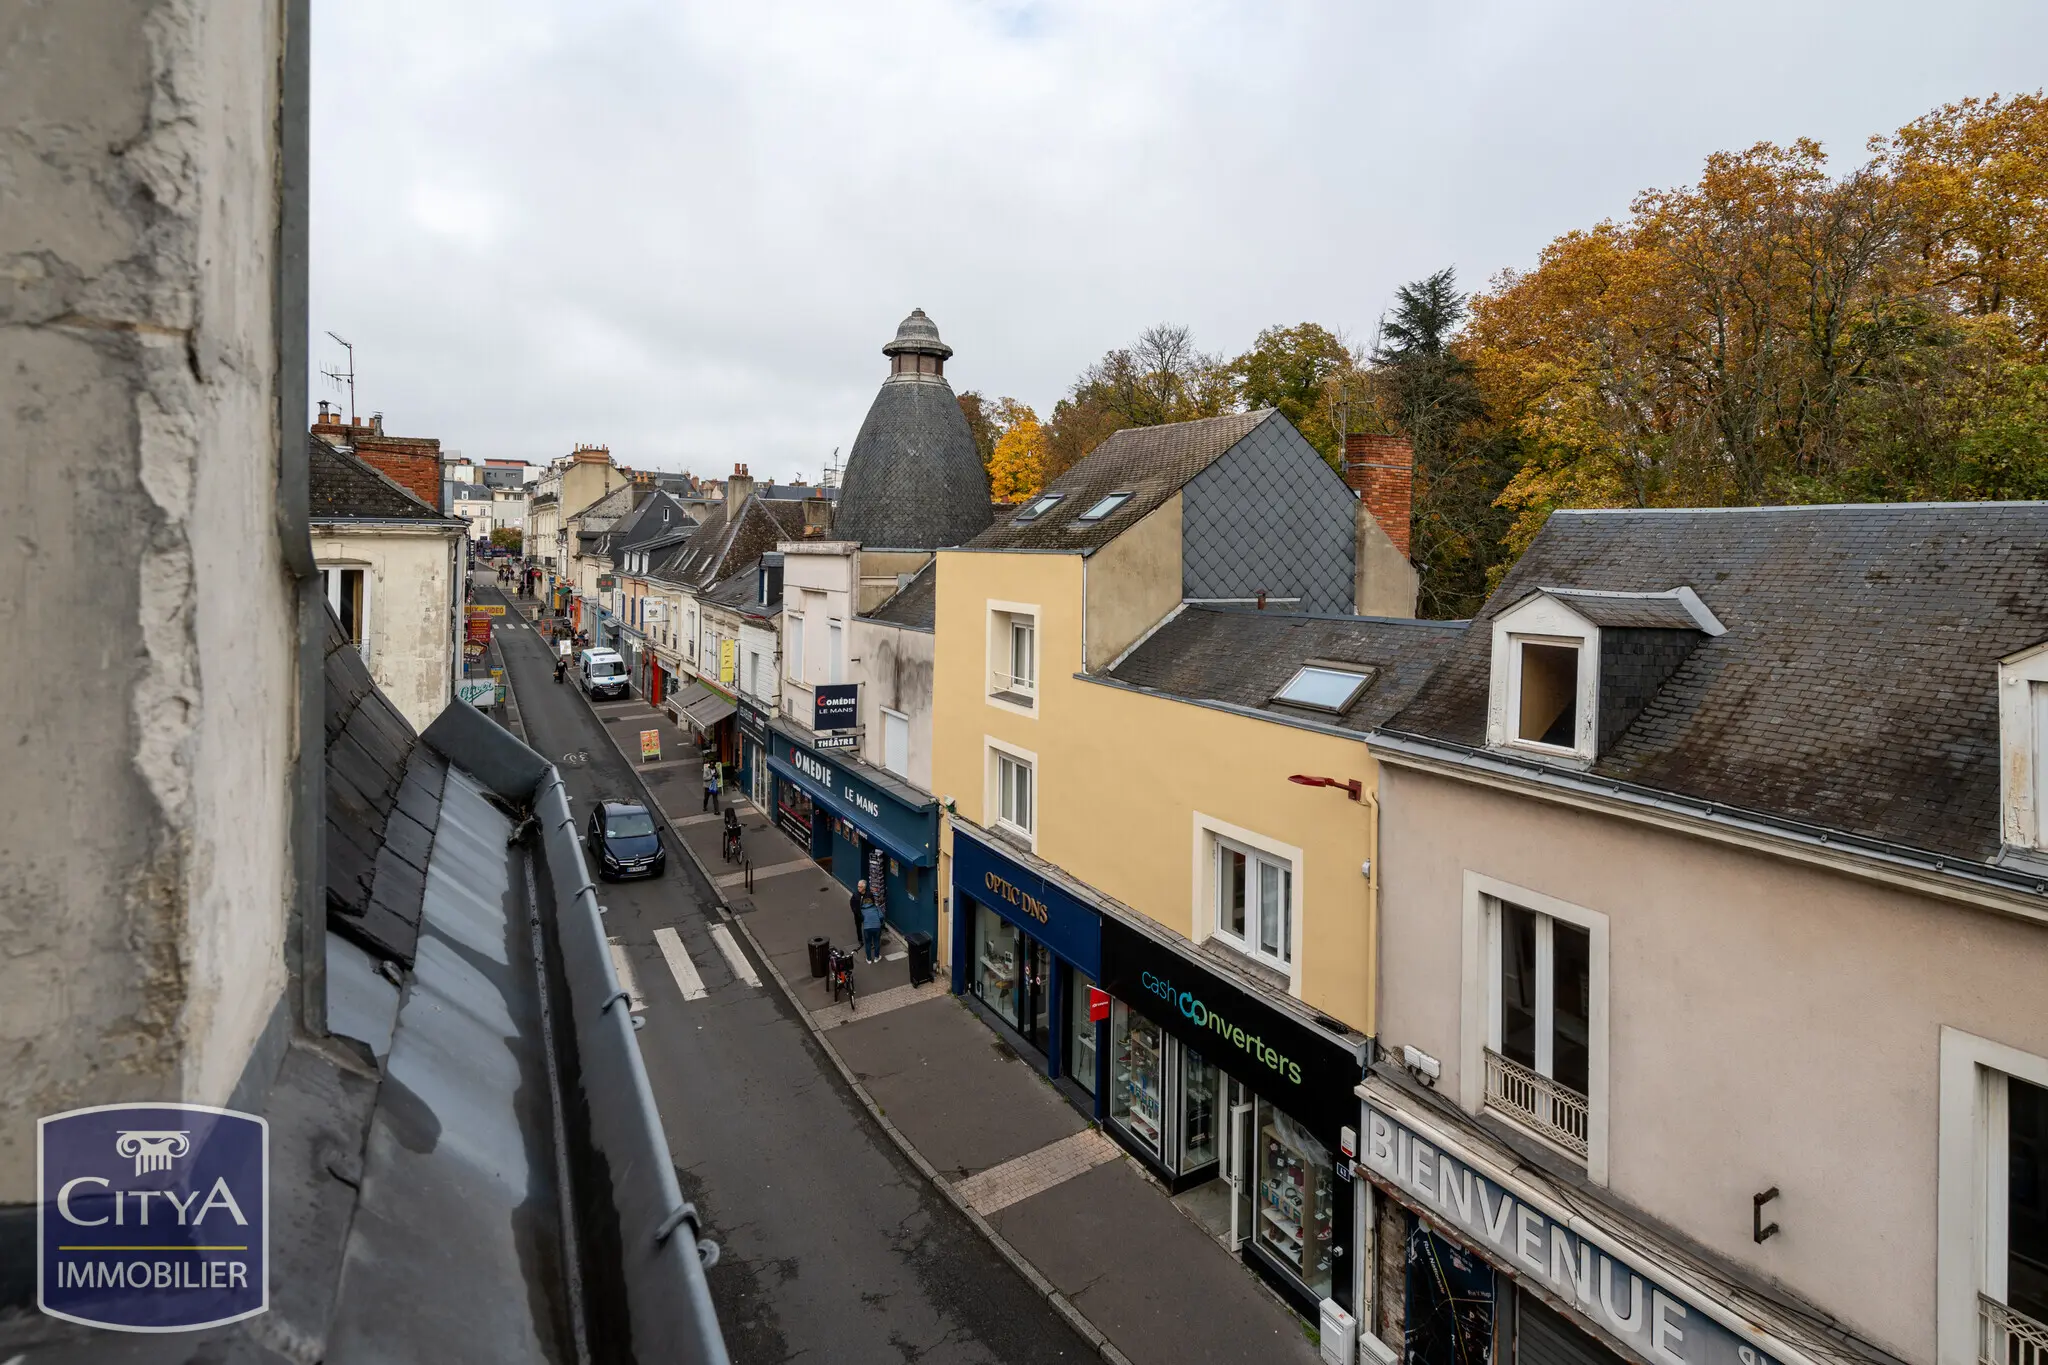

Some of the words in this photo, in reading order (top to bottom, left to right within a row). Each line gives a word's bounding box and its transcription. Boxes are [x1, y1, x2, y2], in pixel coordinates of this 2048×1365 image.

[817, 695, 856, 707] COMÉDIE
[817, 737, 854, 747] THÉÂTRE
[844, 786, 854, 803] LE
[856, 793, 879, 818] MANS
[985, 871, 1020, 906] OPTIC
[1021, 892, 1049, 925] DNS
[1142, 970, 1177, 1007] cash
[1369, 1108, 1689, 1365] BIENVENUE
